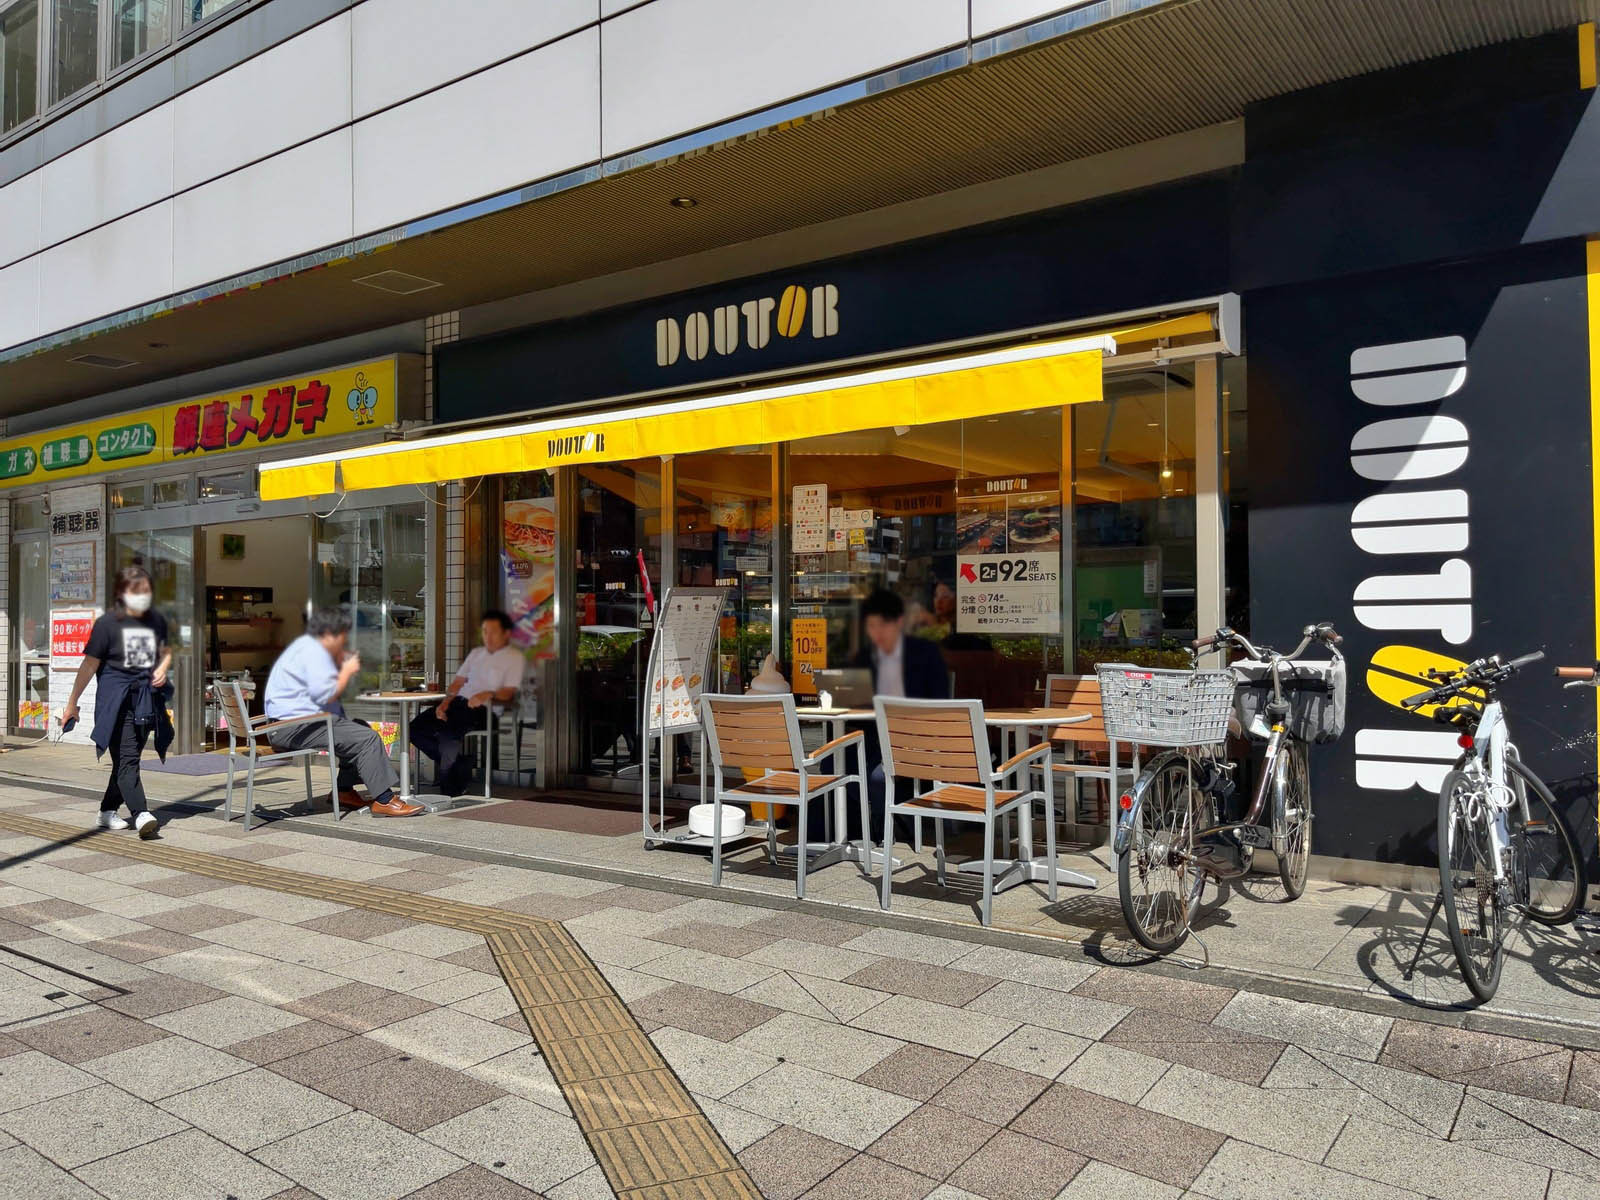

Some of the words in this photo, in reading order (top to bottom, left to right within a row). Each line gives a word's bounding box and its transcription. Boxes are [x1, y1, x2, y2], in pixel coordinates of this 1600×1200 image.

[656, 284, 839, 367] DOUTOR
[173, 380, 330, 456] 銀座メガネ
[99, 424, 152, 453] コンタクト
[548, 431, 605, 459] DOUTOR
[43, 438, 89, 466] 補聴器
[986, 478, 1028, 492] DOUTOR
[52, 511, 99, 535] 補聴器
[982, 566, 997, 578] 2F
[999, 560, 1027, 581] 92
[1029, 560, 1039, 572] 席
[1028, 573, 1057, 581] SEATS
[1349, 335, 1486, 793] DOUTOR
[987, 593, 1000, 603] 74
[988, 605, 999, 614] 18
